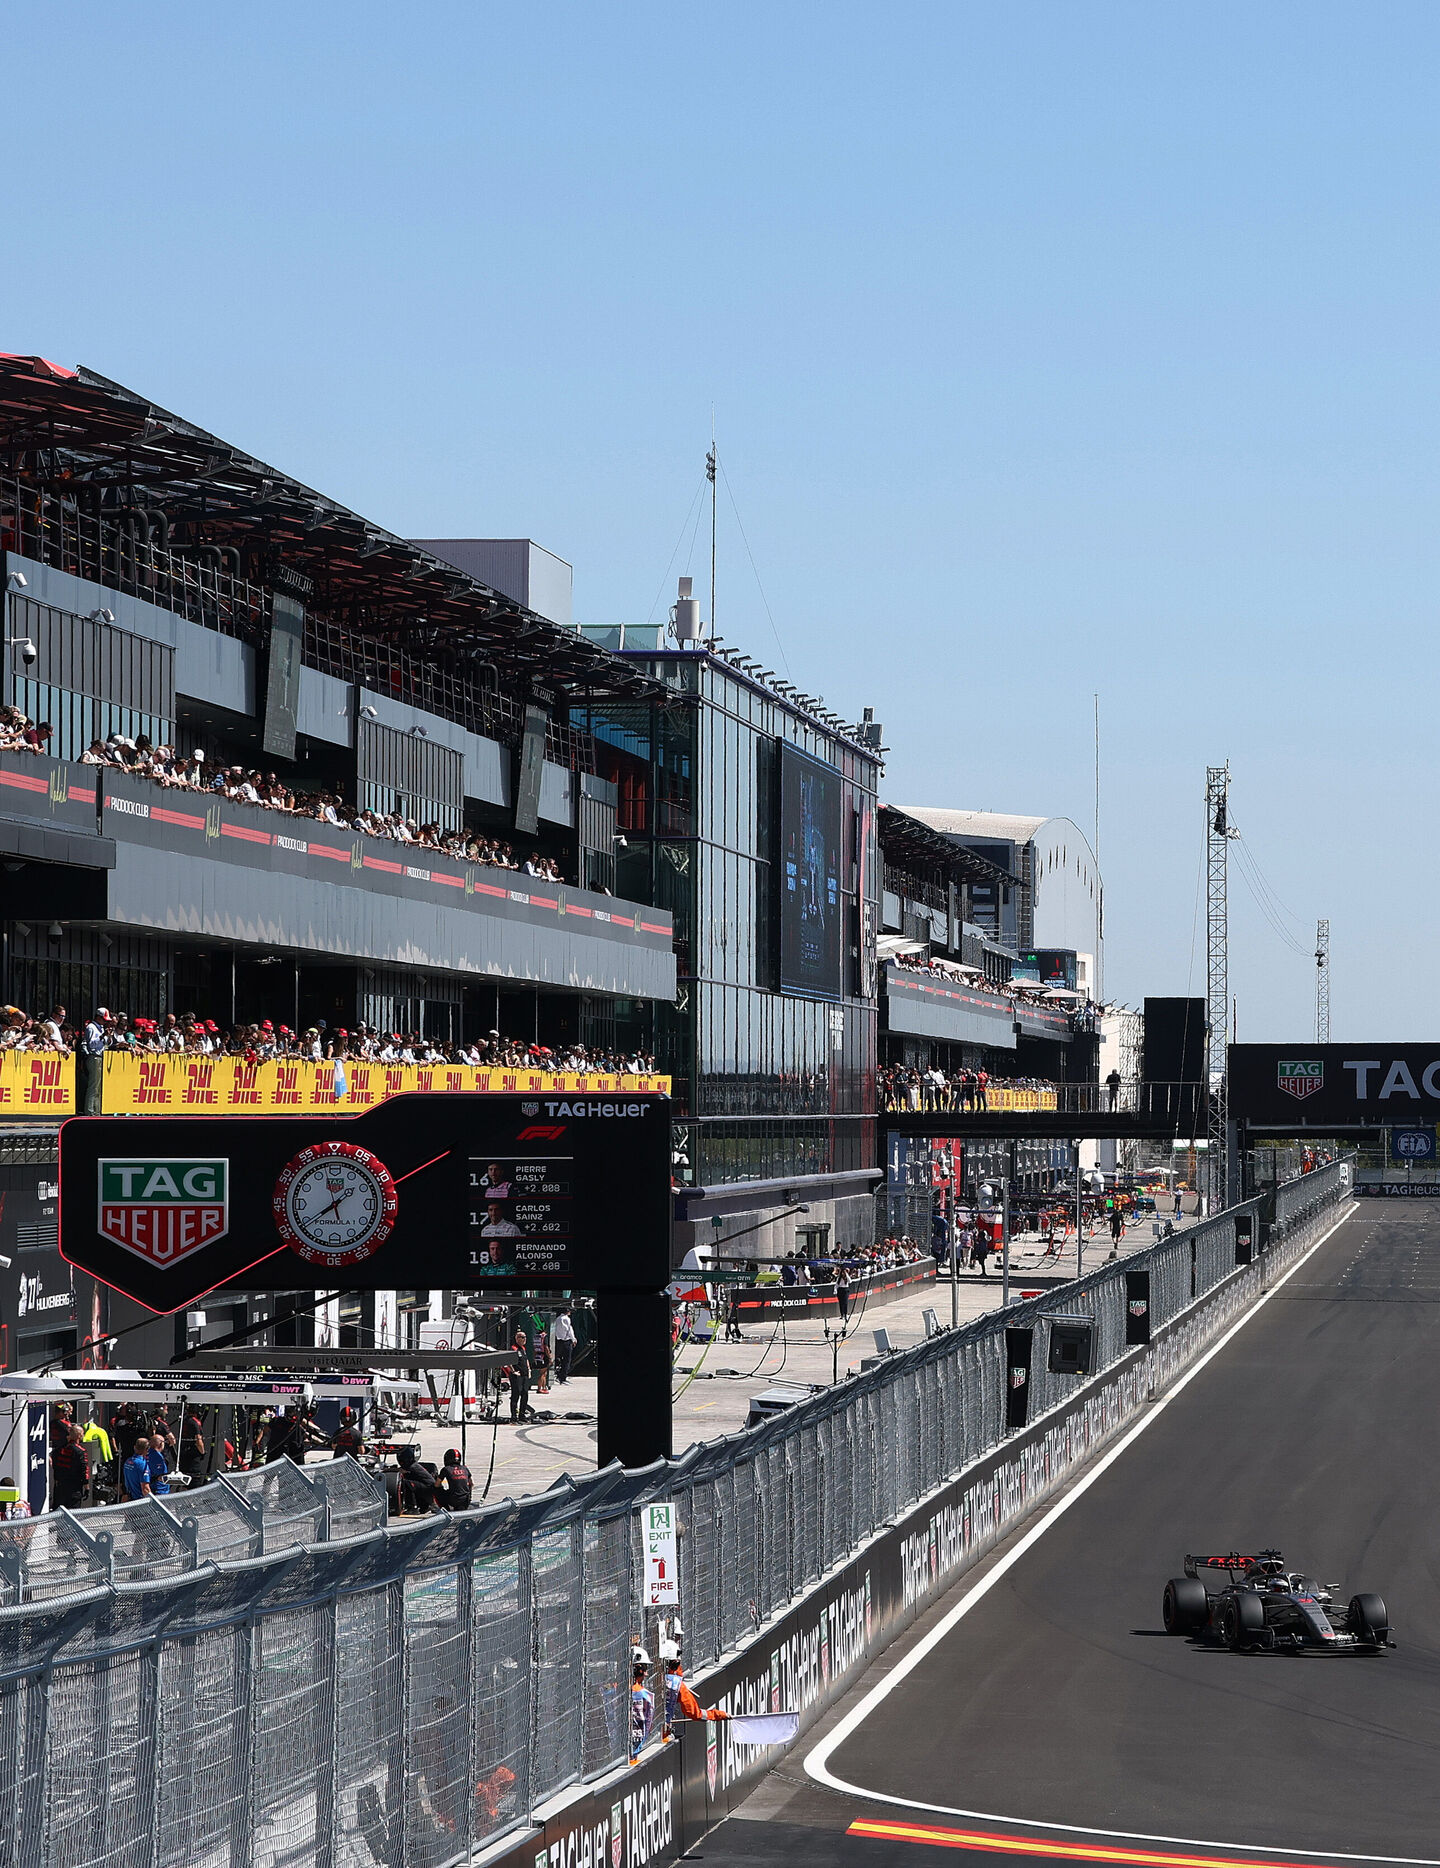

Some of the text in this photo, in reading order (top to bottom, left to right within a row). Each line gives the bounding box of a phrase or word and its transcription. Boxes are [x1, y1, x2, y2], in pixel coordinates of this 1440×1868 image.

[111, 796, 149, 818] PADDOCK CLUB
[277, 834, 307, 853] PADDOCK CLUB
[1282, 1063, 1320, 1075] TAG
[31, 1060, 63, 1103] DHL
[138, 1062, 166, 1103] DHL
[187, 1064, 213, 1103] DHL
[276, 1068, 298, 1103] DHL
[350, 1069, 370, 1103] DHL
[1280, 1077, 1322, 1097] HEUER
[544, 1102, 650, 1117] TAGHeuer
[299, 1149, 314, 1162] 55
[355, 1149, 371, 1162] 05
[110, 1167, 216, 1198] TAG
[378, 1170, 390, 1183] 10
[469, 1173, 489, 1186] 16
[515, 1174, 545, 1182] GASLY
[387, 1199, 396, 1211] 15
[469, 1212, 489, 1225] 17
[515, 1213, 543, 1221] SAINZ
[107, 1210, 220, 1259] HEUER
[469, 1251, 490, 1264] 18
[515, 1252, 553, 1260] ALONSO
[307, 1357, 363, 1366] visitQATAR
[172, 1382, 191, 1390] MSC
[649, 1531, 672, 1540] EXIT
[651, 1582, 674, 1591] FIRE
